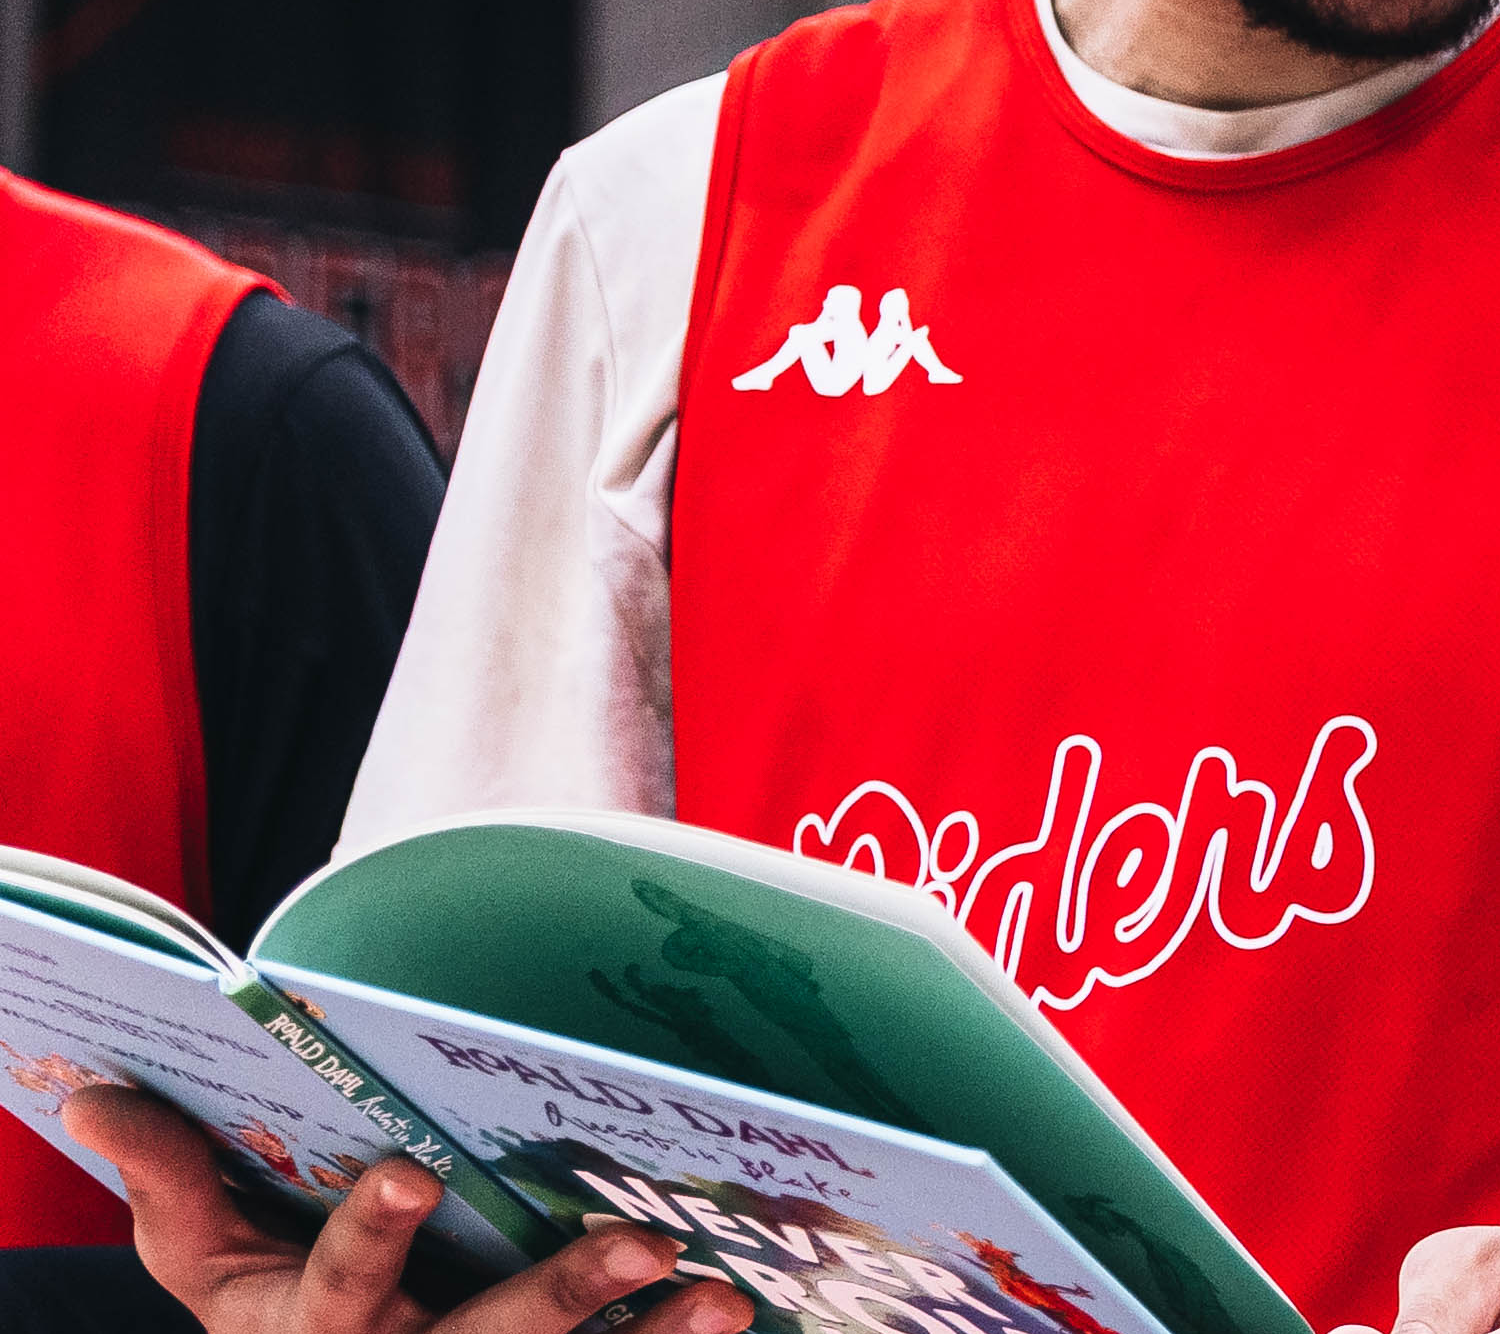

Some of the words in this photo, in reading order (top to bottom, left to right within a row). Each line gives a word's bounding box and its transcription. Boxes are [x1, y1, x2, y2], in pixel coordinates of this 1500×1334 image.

[247, 1092, 304, 1121] UP
[263, 1012, 325, 1061] ROALD
[314, 1054, 364, 1099] DAHL
[416, 1032, 655, 1116] ROALD
[661, 1097, 877, 1180] DAHL
[572, 1169, 1012, 1322] NEVER
